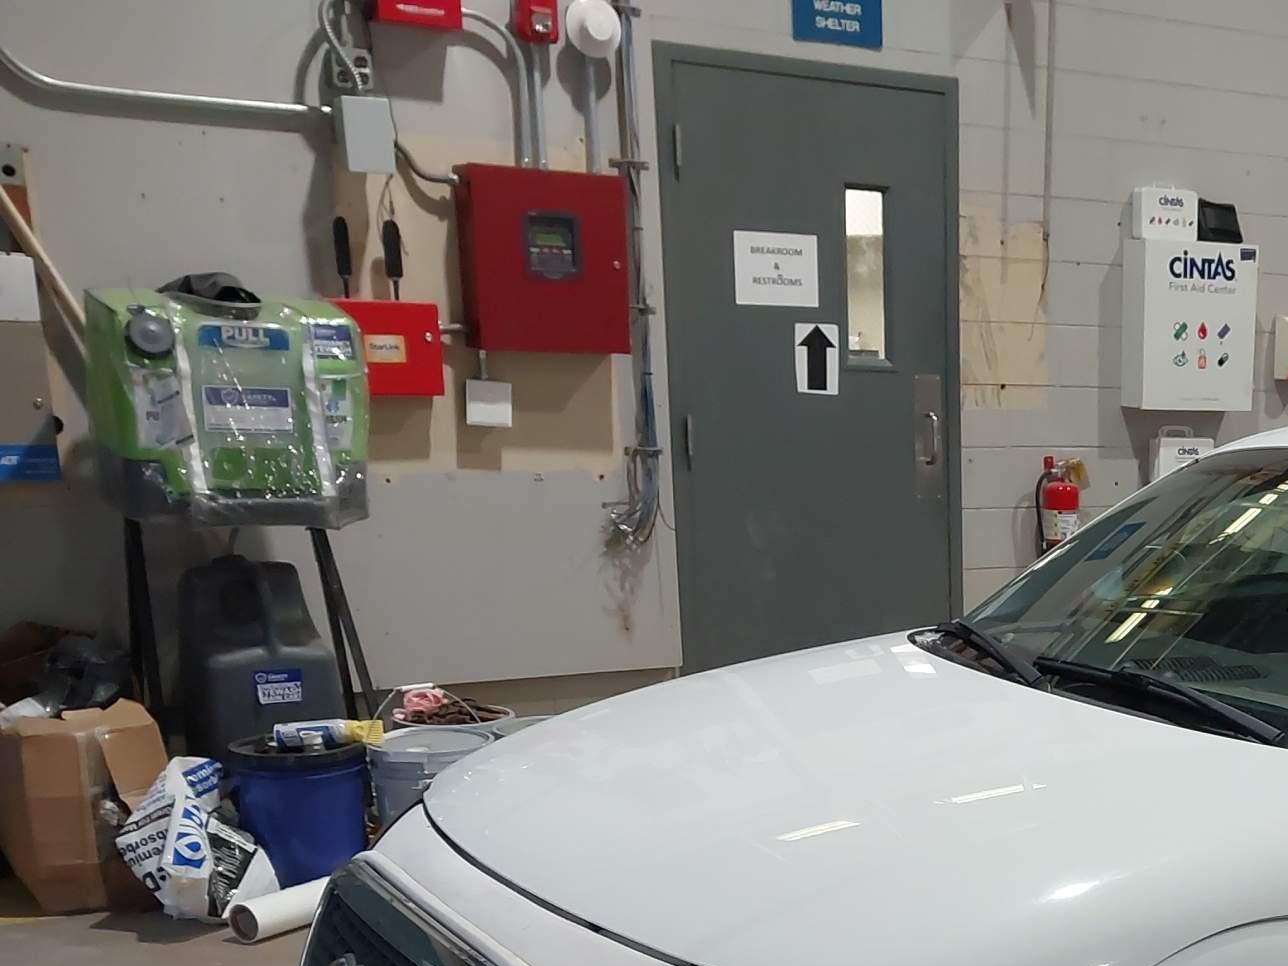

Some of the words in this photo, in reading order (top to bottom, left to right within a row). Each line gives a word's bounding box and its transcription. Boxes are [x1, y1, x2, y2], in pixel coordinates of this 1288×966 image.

[813, 0, 862, 16] WEATHER
[815, 16, 860, 32] SHELTER
[750, 246, 803, 256] BREAKROOM
[752, 276, 803, 287] RESTROOMS
[1168, 281, 1189, 292] First
[1190, 282, 1206, 293] Aid
[1207, 283, 1237, 295] Center
[221, 326, 270, 343] PULL
